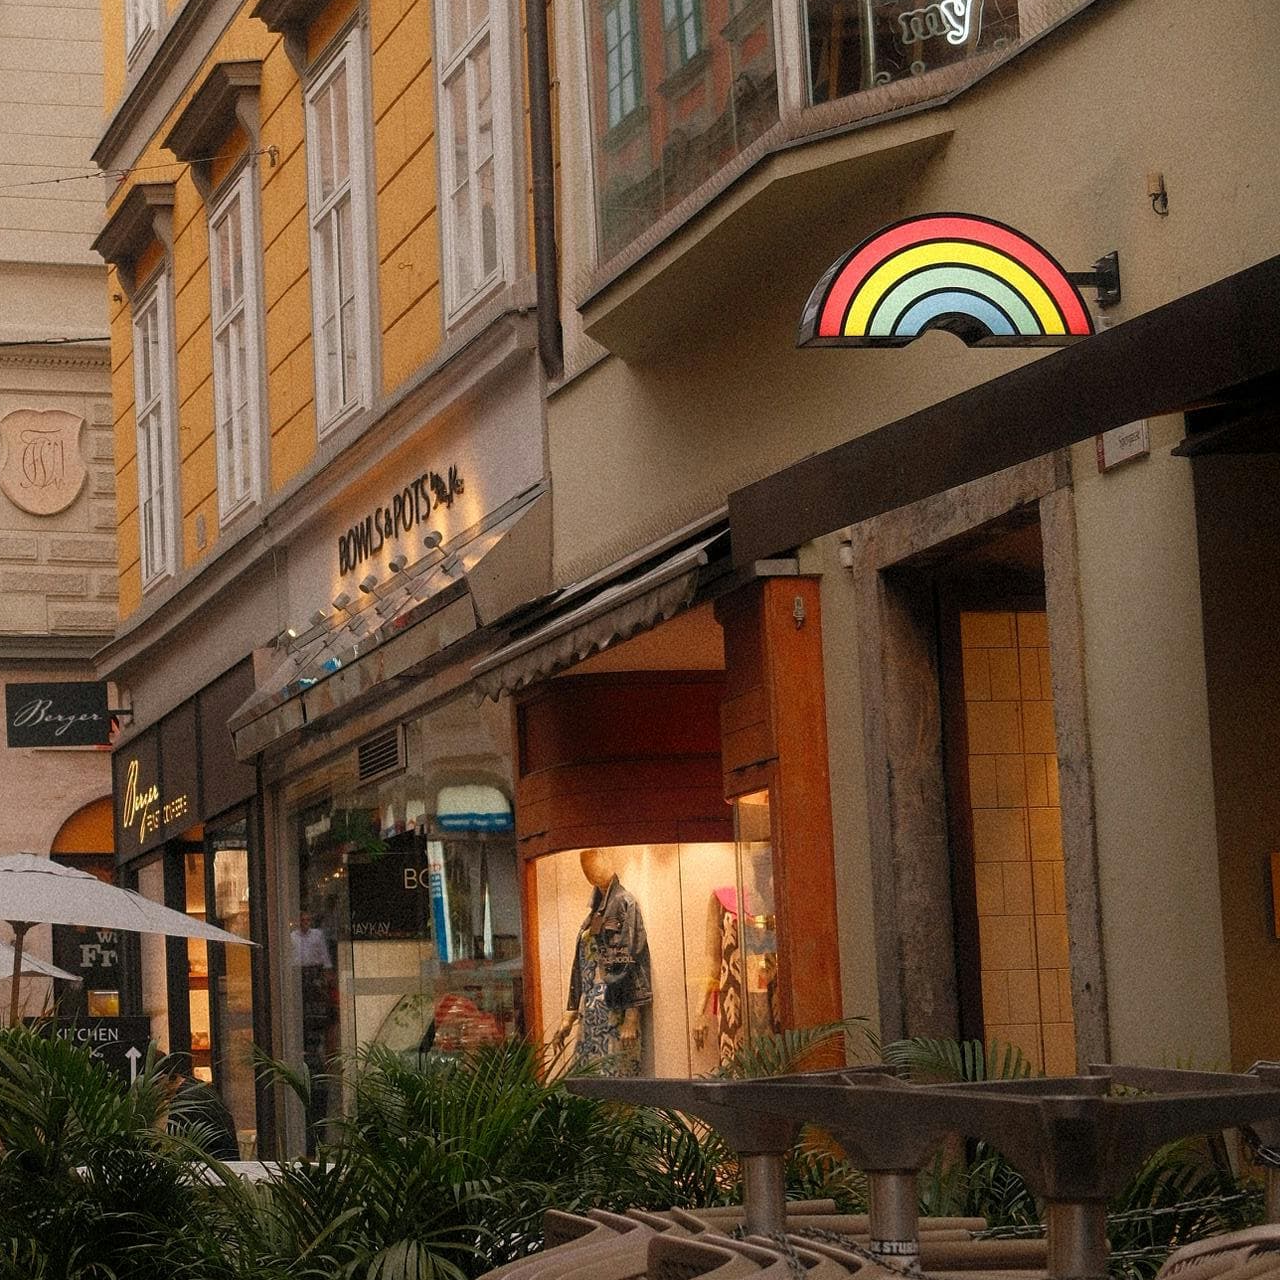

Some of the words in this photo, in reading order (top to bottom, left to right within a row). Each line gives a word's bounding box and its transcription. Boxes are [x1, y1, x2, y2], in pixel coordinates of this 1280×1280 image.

[13, 698, 103, 736] Berger
[123, 759, 160, 844] Berger
[79, 944, 119, 968] Fr
